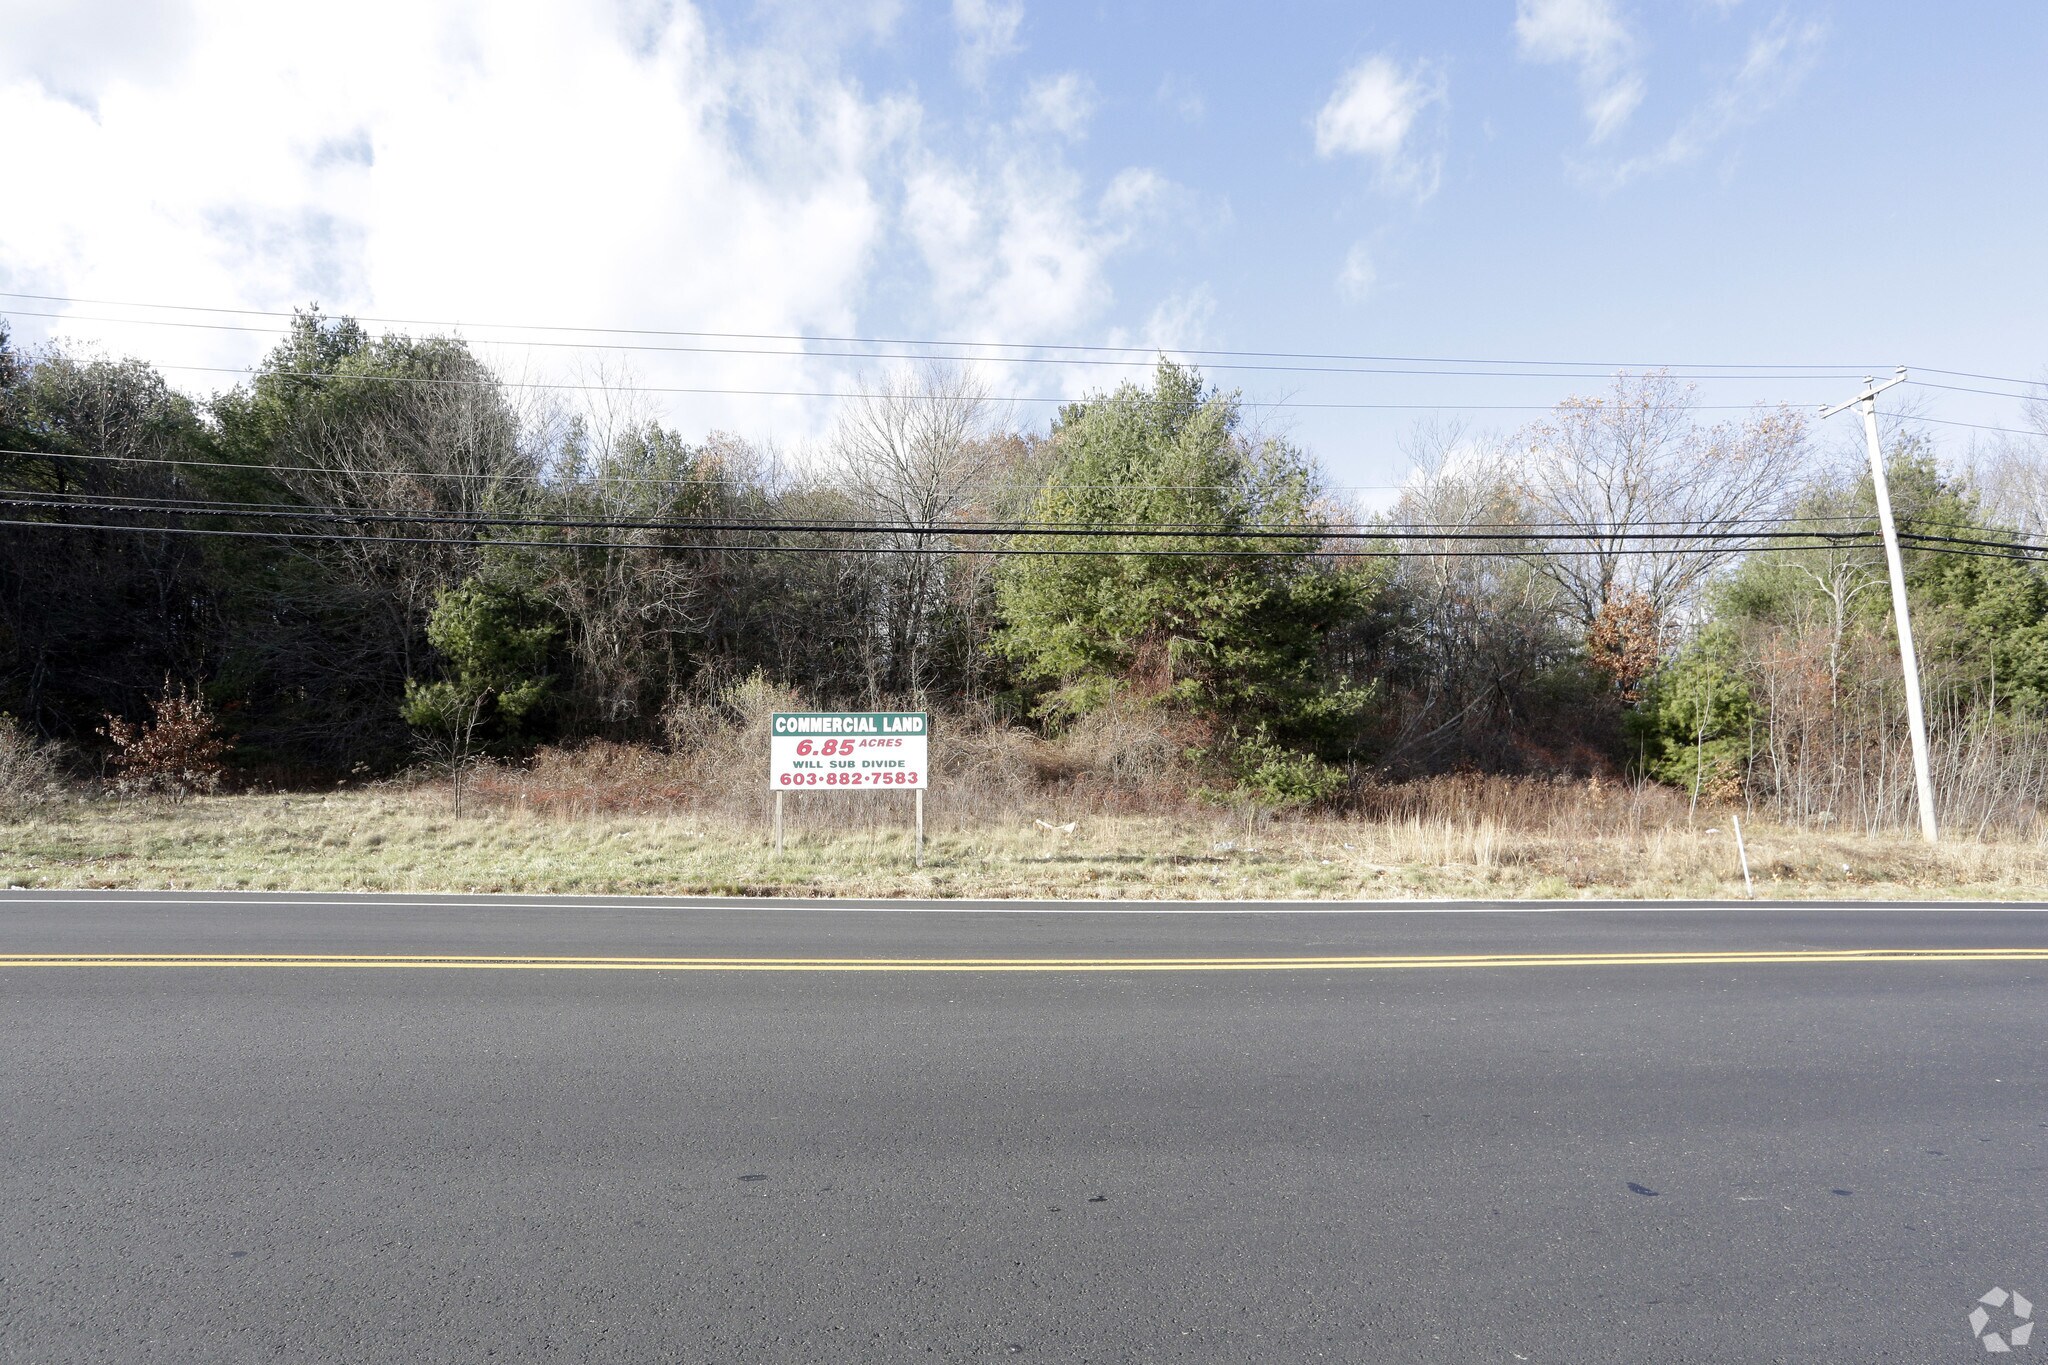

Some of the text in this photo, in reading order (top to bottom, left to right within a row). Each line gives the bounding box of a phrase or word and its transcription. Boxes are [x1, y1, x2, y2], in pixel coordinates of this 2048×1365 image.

[775, 716, 923, 733] COMMERCIAL LAND
[796, 738, 903, 756] 6.85 ACRES
[793, 760, 905, 768] WILL SUB DIVIDE
